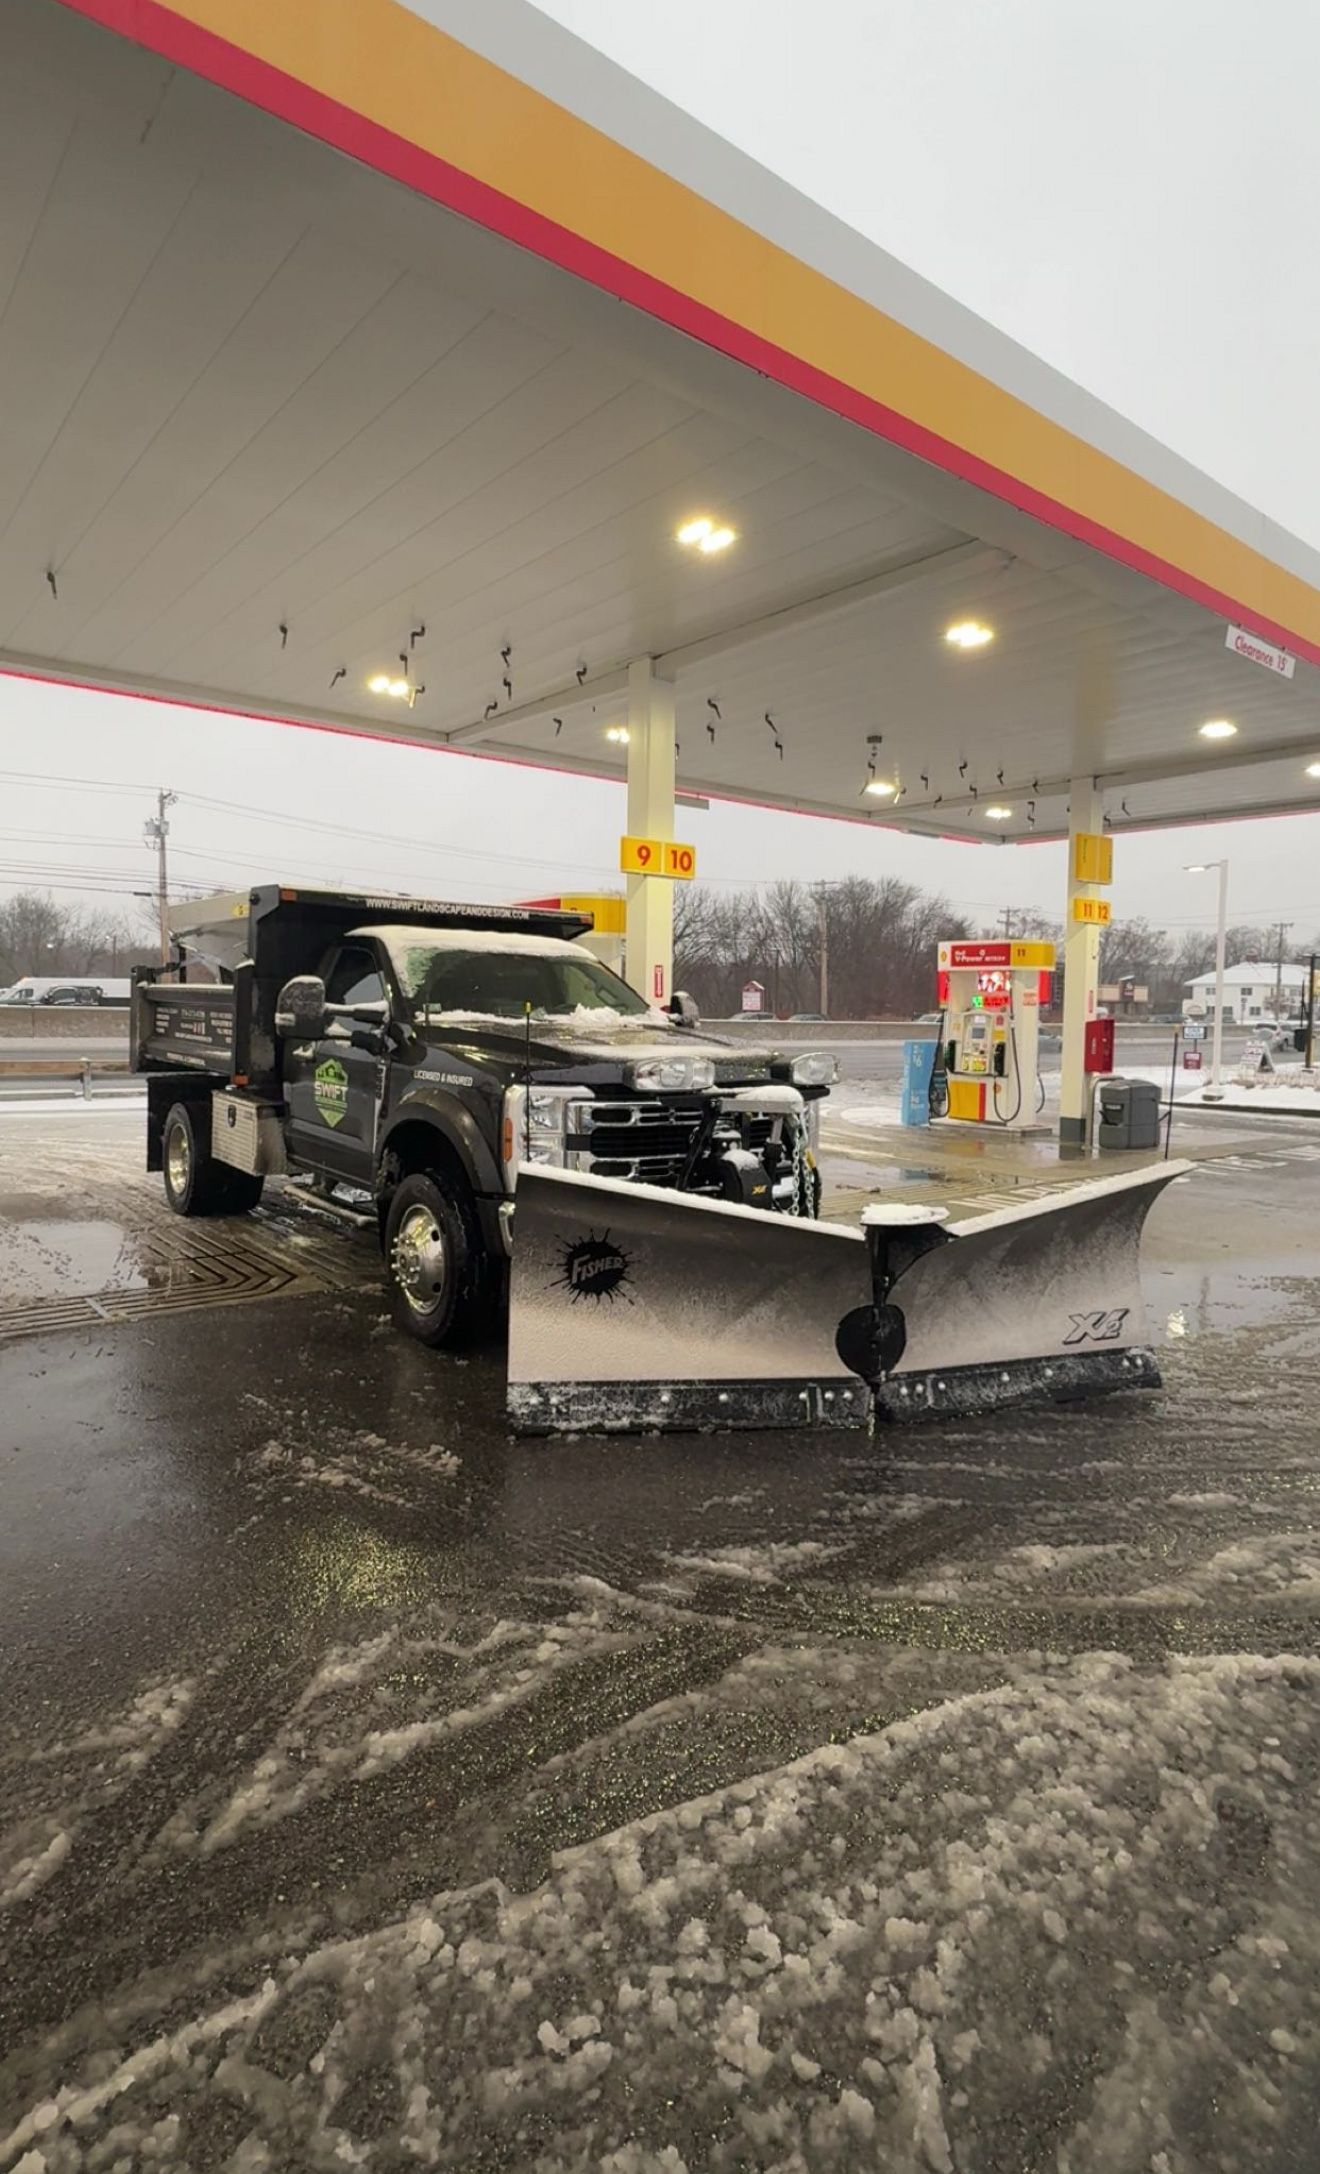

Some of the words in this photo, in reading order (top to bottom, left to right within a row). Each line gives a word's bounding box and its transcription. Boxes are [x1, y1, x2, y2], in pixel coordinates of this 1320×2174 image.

[1235, 635, 1273, 667] Clearance
[637, 845, 651, 866] 9
[671, 849, 692, 872] 10
[1084, 903, 1092, 917] 11
[1099, 905, 1108, 919] 12
[314, 1081, 349, 1101] SWIFT
